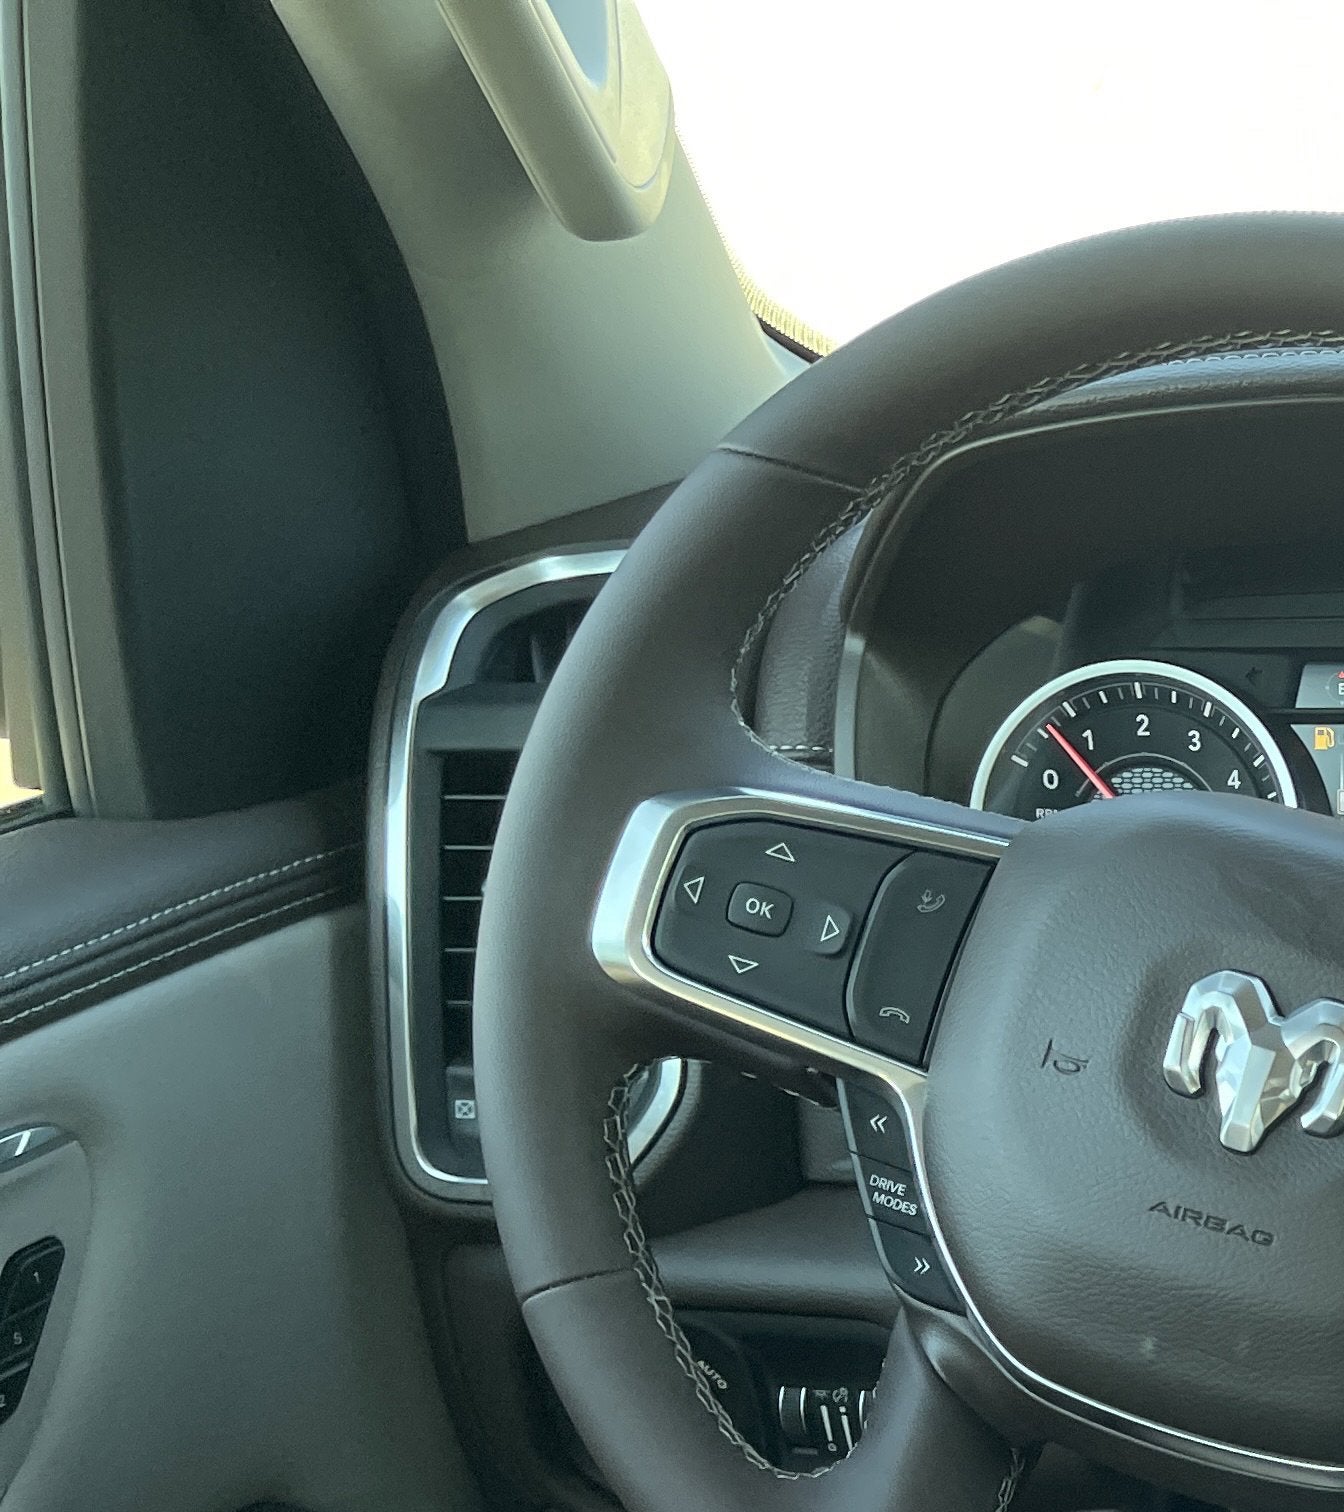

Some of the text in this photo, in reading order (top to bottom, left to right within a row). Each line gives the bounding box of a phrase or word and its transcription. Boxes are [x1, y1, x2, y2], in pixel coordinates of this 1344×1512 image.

[1134, 714, 1151, 736] 2
[1081, 728, 1095, 751] 1
[1187, 729, 1202, 753] 3
[1041, 768, 1060, 791] 0
[1226, 769, 1242, 790] 4
[744, 897, 774, 920] OK
[868, 1173, 906, 1197] DRIVE
[872, 1190, 918, 1217] MODES
[1148, 1200, 1276, 1247] AIRBAG
